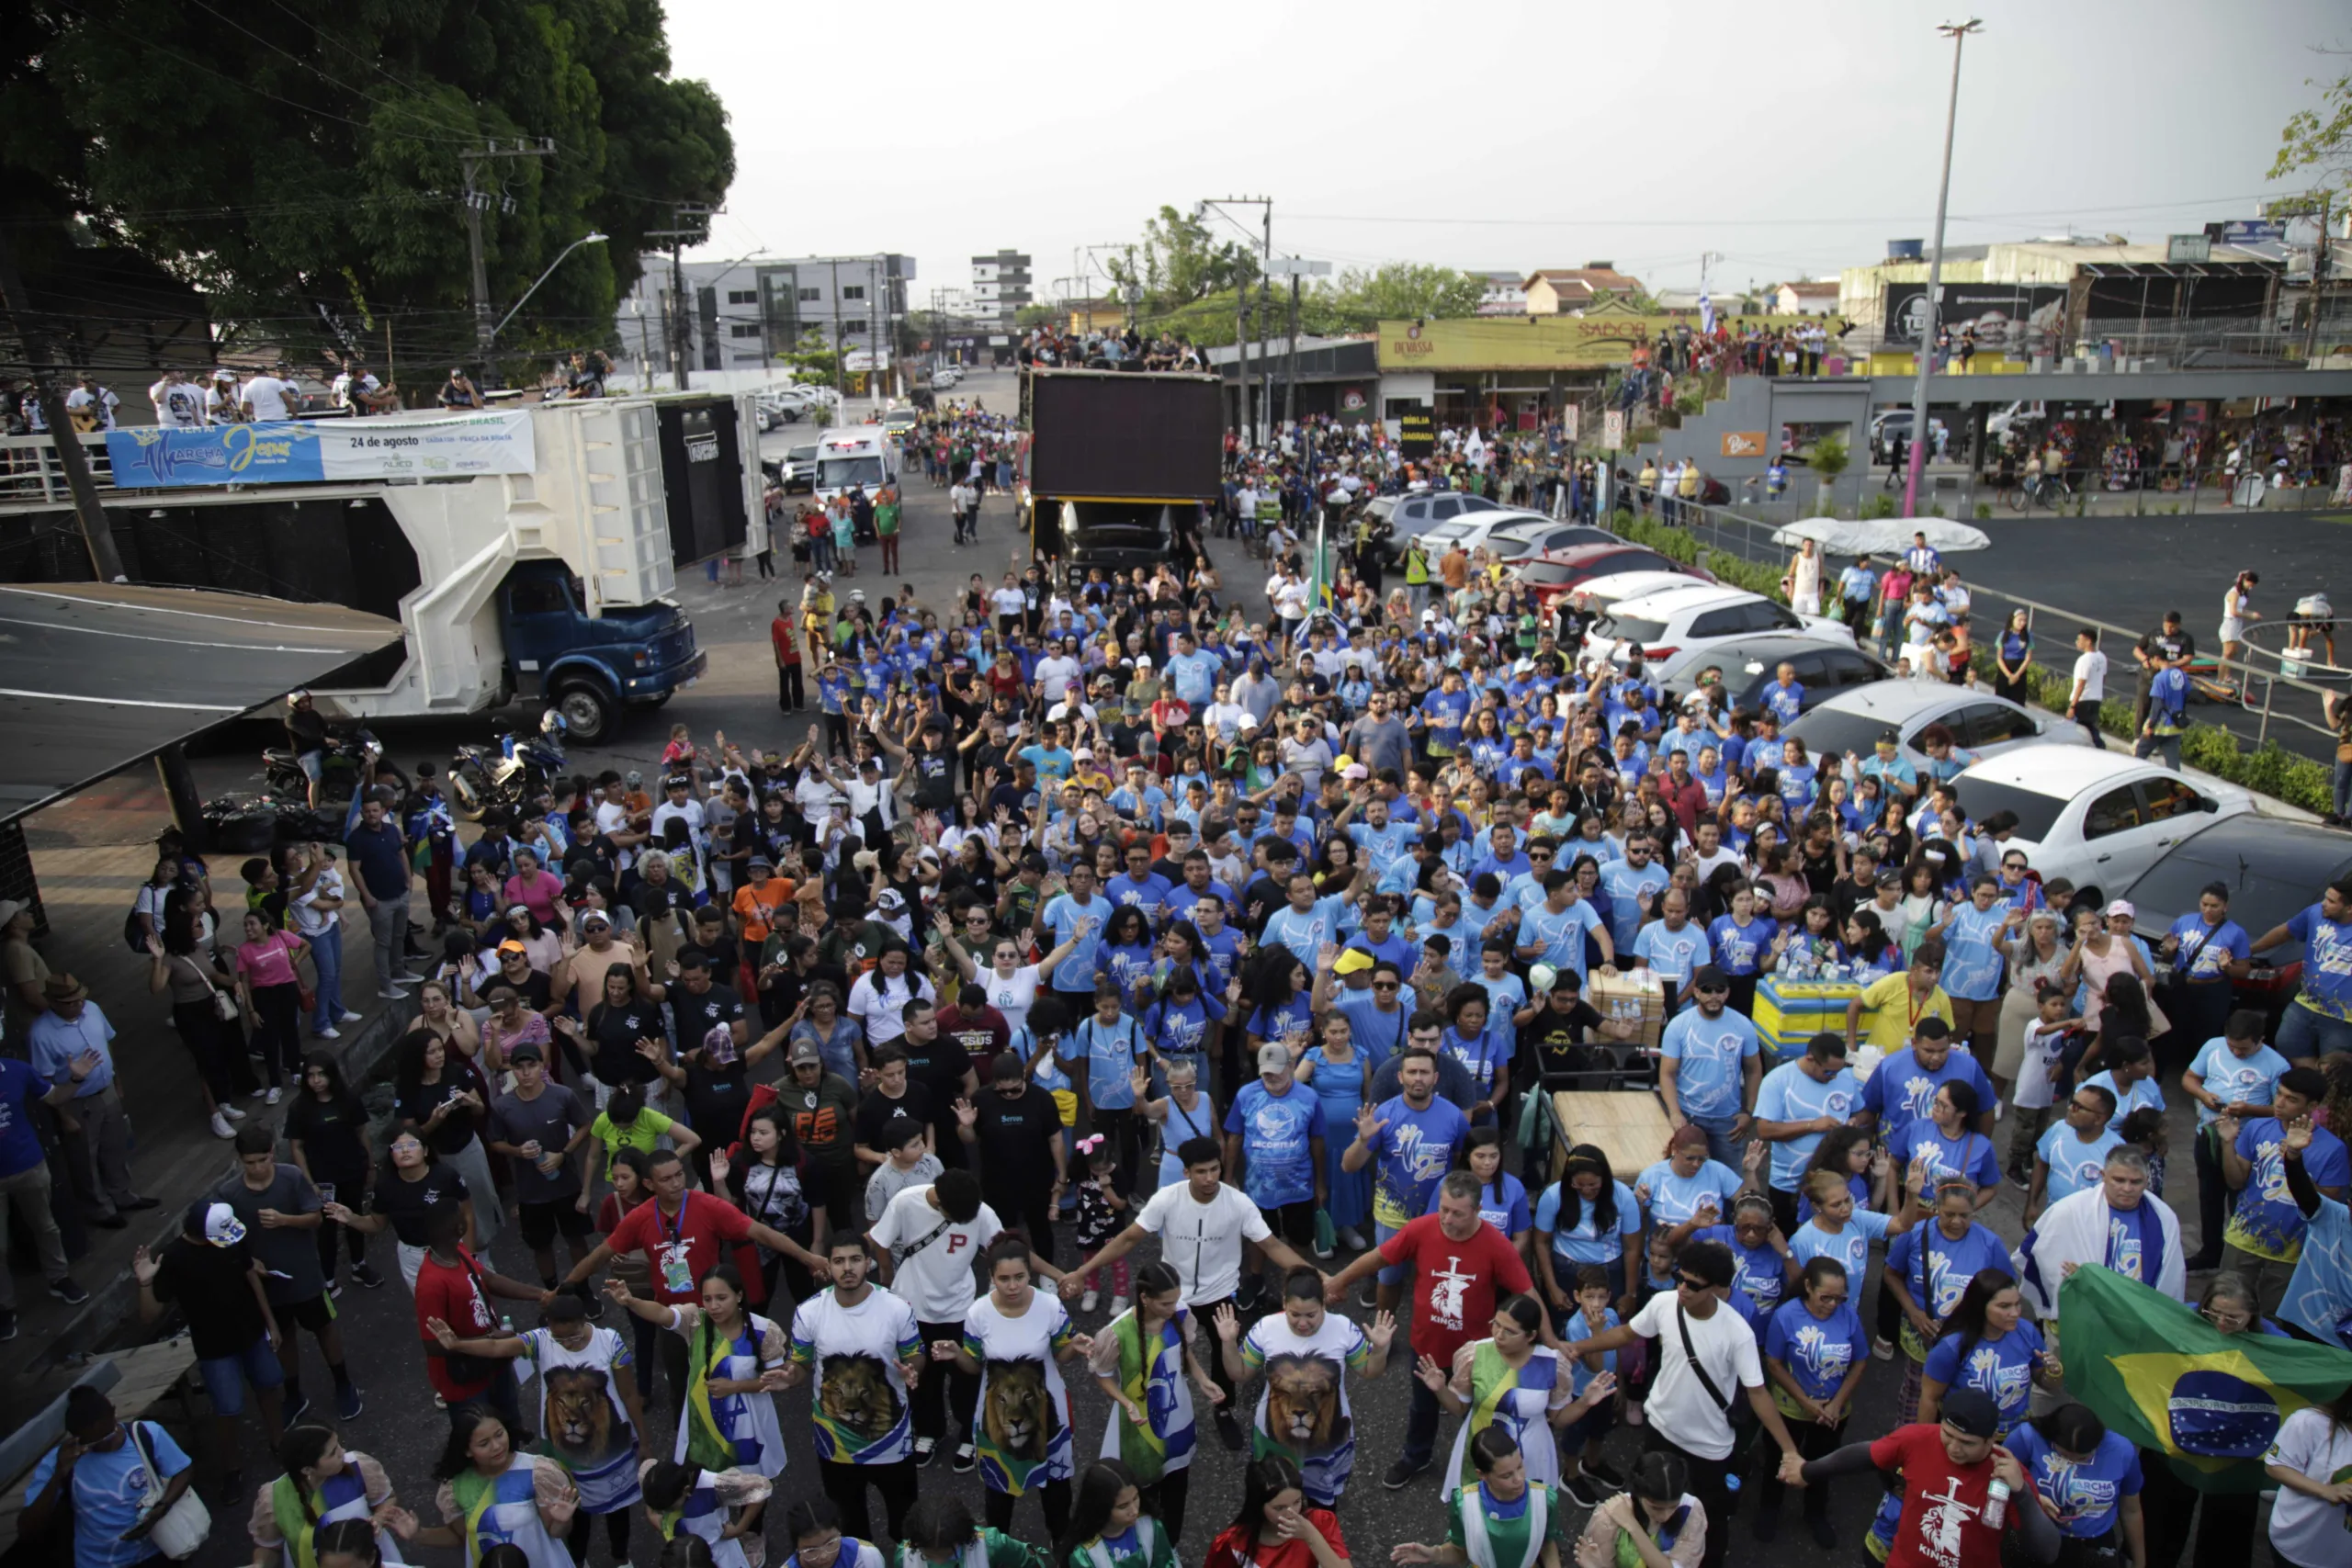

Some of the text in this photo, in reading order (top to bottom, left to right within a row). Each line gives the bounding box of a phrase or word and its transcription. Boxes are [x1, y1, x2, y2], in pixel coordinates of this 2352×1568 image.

[1395, 341, 1434, 355] DEVASSA
[469, 416, 505, 425] BRASIL
[350, 437, 364, 448] 24
[368, 436, 379, 447] de
[383, 435, 419, 449] agosto
[1402, 431, 1434, 442] SAGRADA
[959, 1035, 993, 1046] ESUS
[908, 1057, 931, 1066] Servos
[1001, 1114, 1023, 1123] Servos
[947, 1234, 968, 1254] P
[1430, 1314, 1464, 1327] KING'S
[1918, 1543, 1960, 1566] KING'S
